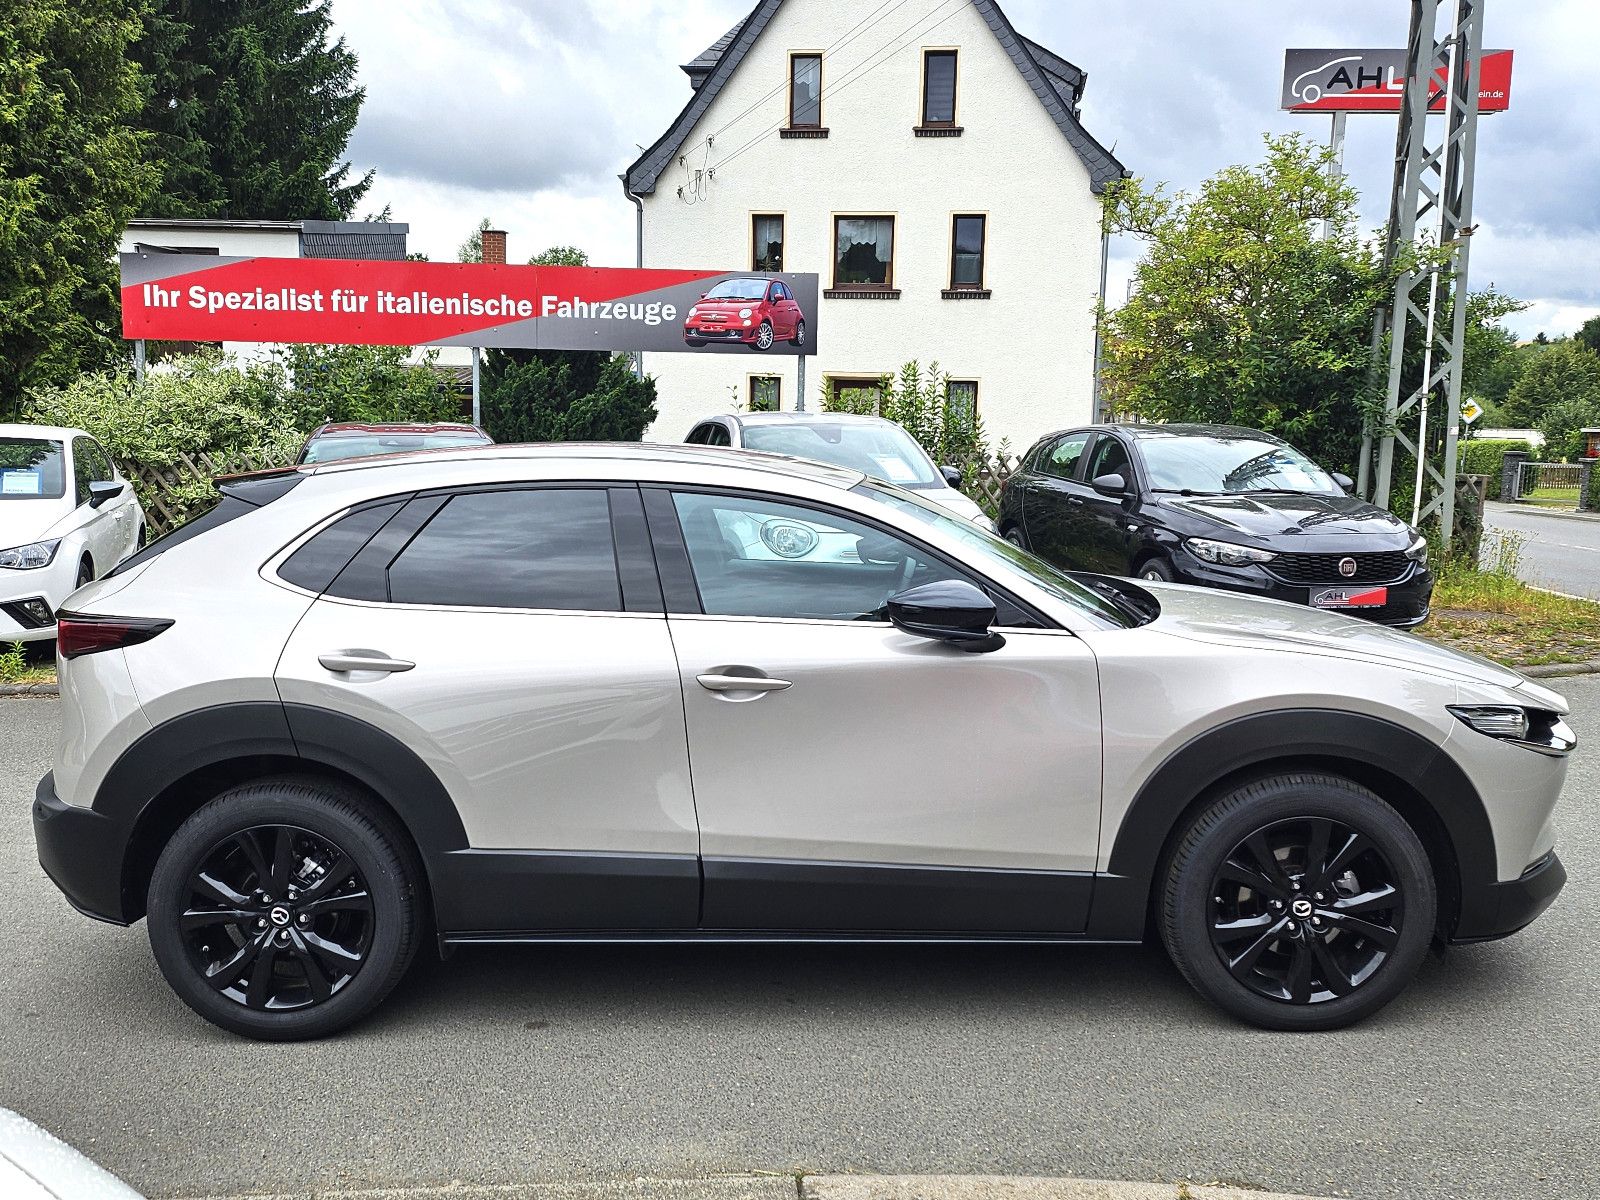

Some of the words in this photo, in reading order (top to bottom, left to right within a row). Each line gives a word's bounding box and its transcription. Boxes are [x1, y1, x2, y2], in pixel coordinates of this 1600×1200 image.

[1327, 66, 1403, 90] AHL
[143, 284, 181, 308] Ihr
[188, 285, 324, 313] Spezialist
[331, 289, 369, 312] für
[377, 291, 533, 316] italienische
[541, 295, 677, 325] Fahrzeuge
[1325, 592, 1350, 600] AHL
